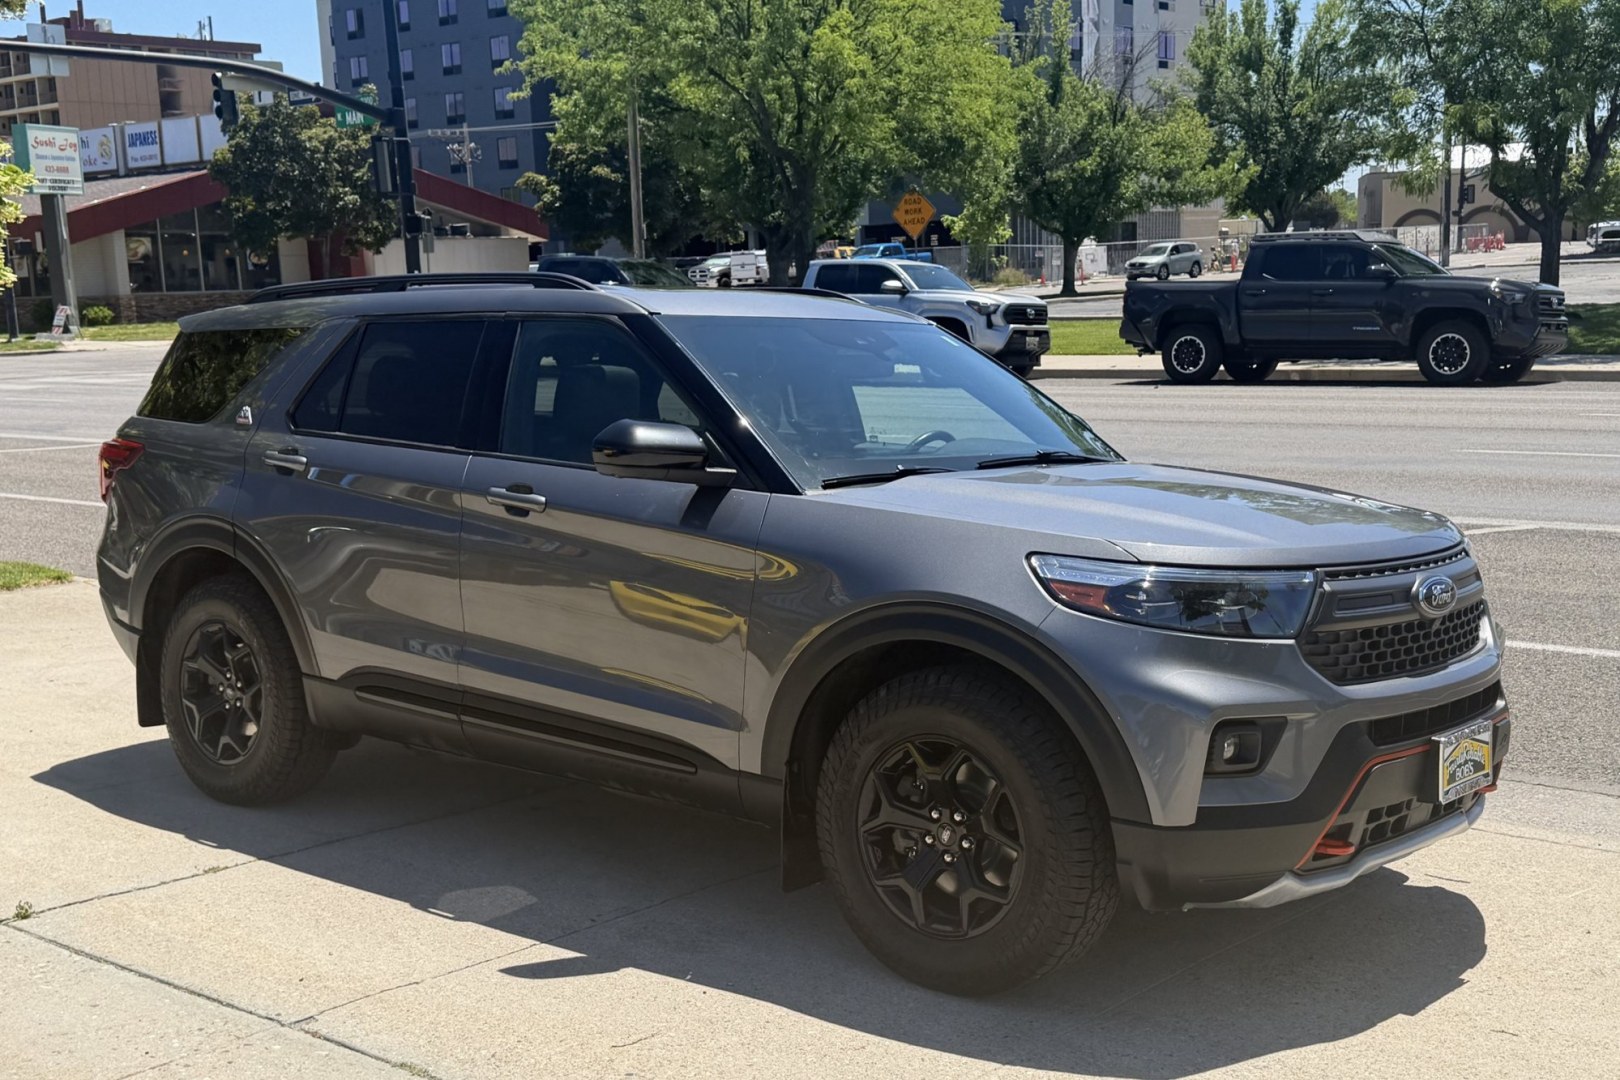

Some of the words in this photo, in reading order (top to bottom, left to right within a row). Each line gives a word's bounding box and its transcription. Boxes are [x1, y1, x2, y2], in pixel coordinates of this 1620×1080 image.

[346, 111, 364, 125] MAIN
[31, 136, 56, 149] Sushi
[128, 130, 158, 148] JAPANESE
[904, 217, 925, 225] AHEAD
[1431, 584, 1451, 606] Ford
